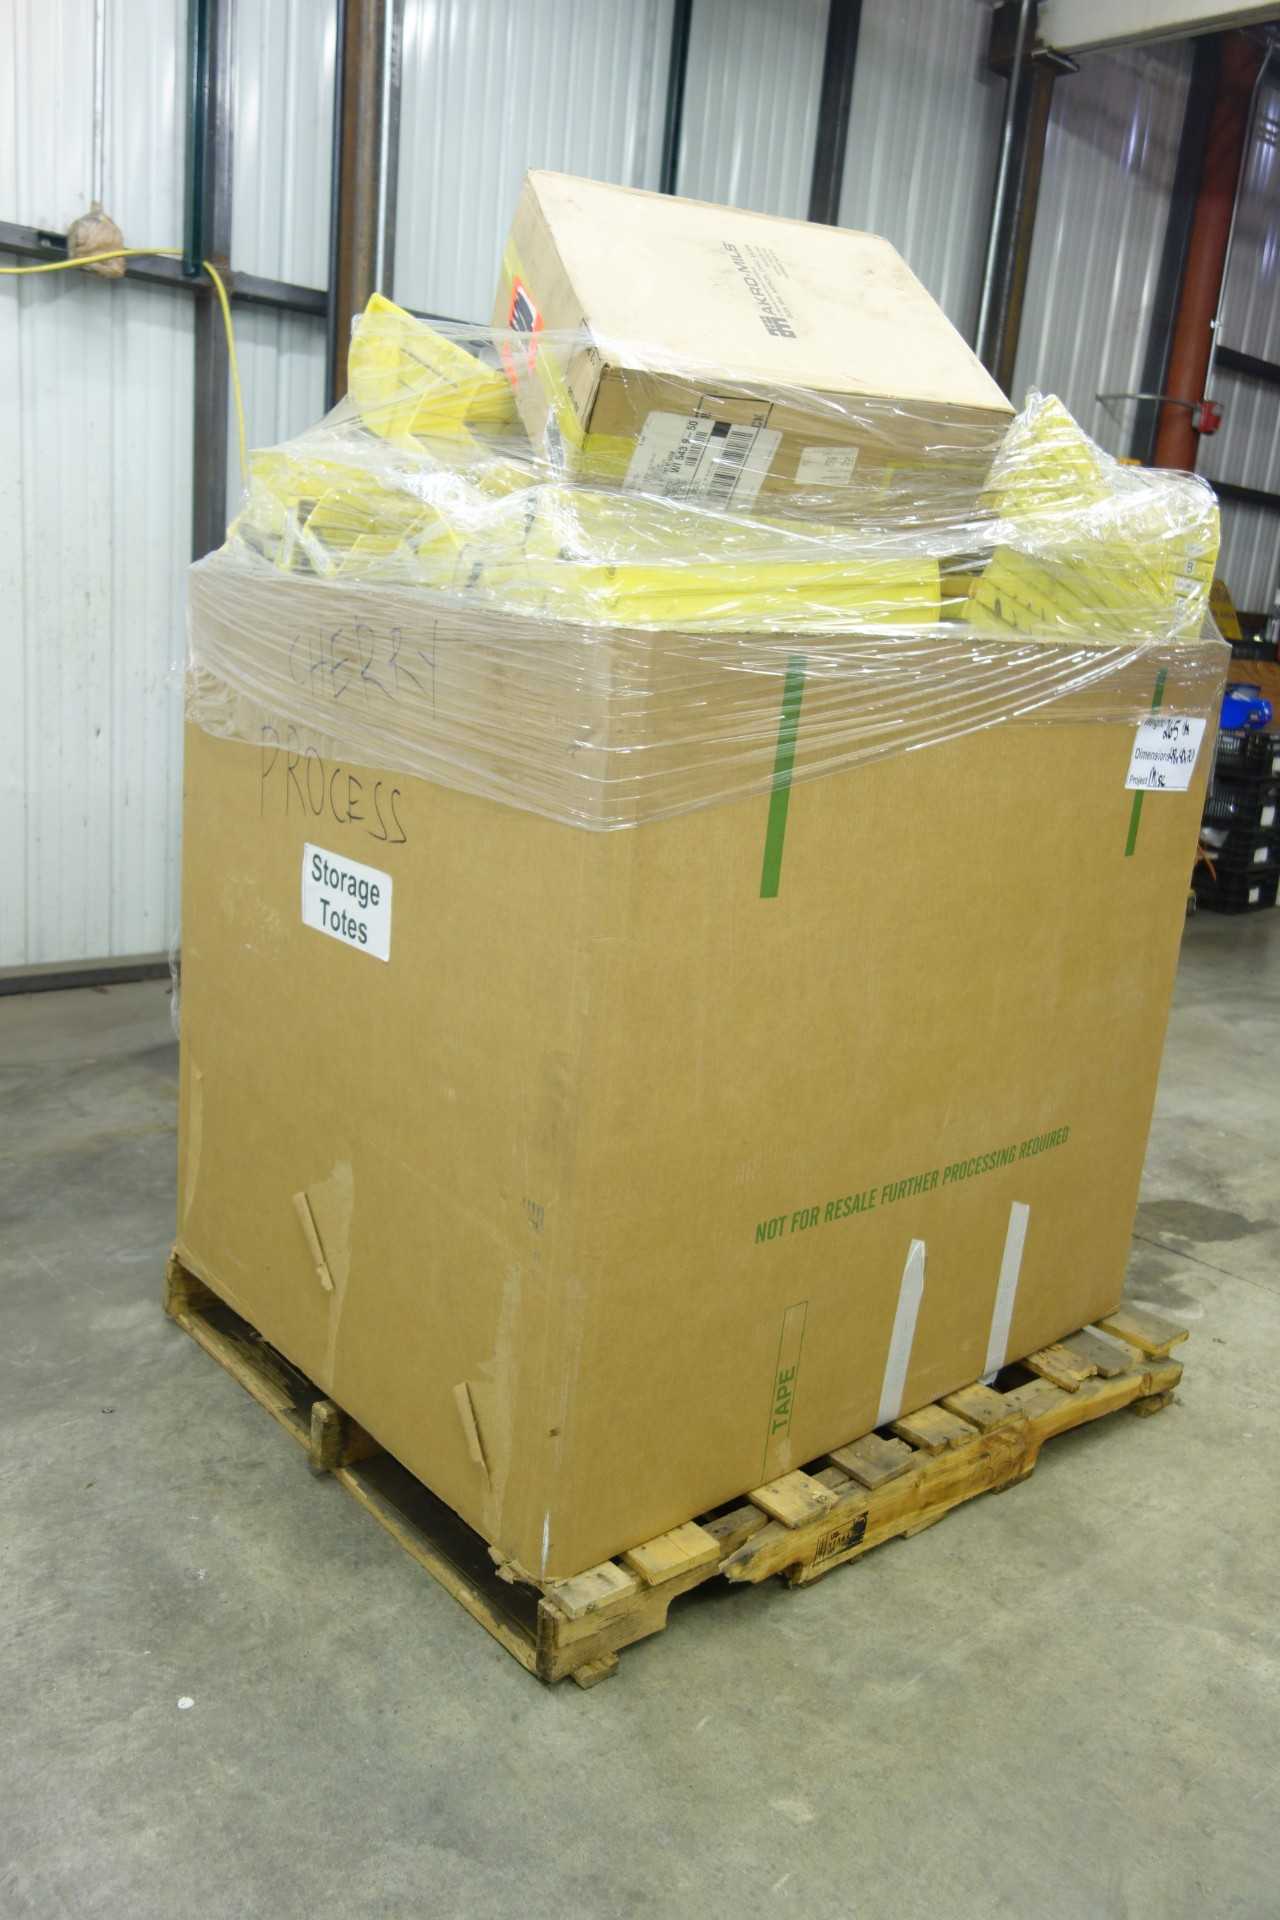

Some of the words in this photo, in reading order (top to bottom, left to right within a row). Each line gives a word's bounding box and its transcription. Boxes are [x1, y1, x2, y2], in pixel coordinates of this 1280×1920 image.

[288, 616, 438, 720] CHERRY
[260, 725, 407, 843] PROCESS
[311, 854, 380, 909] Storage
[319, 898, 368, 945] Totes
[754, 1215, 787, 1244] NOT
[790, 1206, 820, 1232] FOR
[824, 1188, 878, 1223] RESALE
[881, 1170, 939, 1205] FURTHER
[943, 1144, 1017, 1186] PROCESSING
[1018, 1125, 1070, 1161] REQUIRED
[771, 1364, 796, 1436] TAPE
